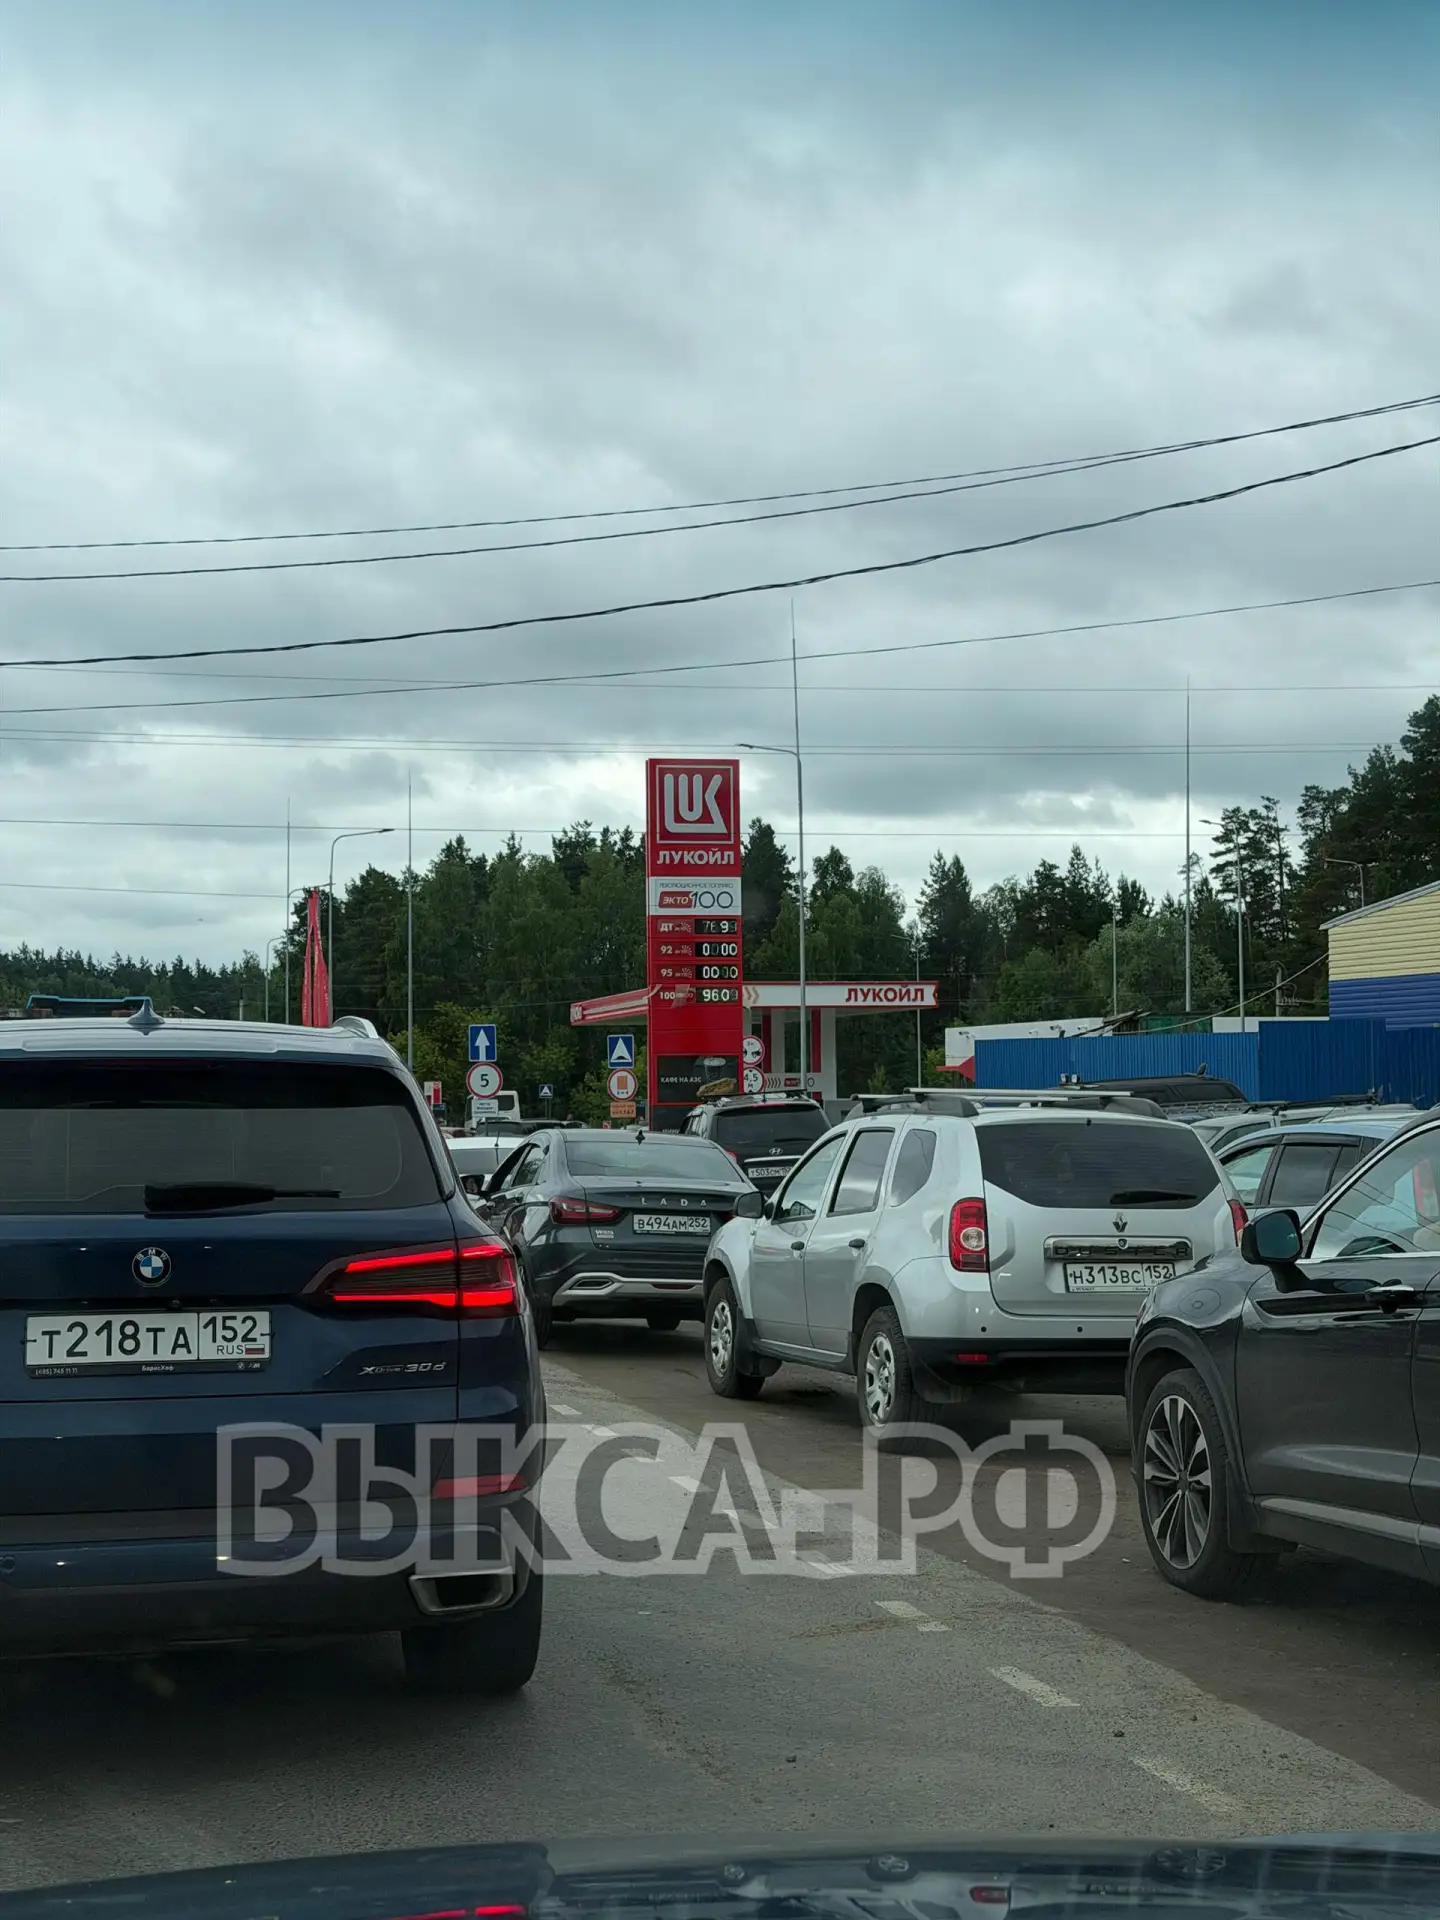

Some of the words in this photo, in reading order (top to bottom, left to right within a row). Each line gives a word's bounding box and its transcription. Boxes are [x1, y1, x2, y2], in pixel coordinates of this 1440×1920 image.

[656, 848, 734, 865] ЛУКОЙЛ
[662, 896, 689, 905] ЭКТО
[692, 891, 733, 909] 100
[660, 923, 674, 932] ДТ
[660, 946, 673, 954] 92
[660, 968, 673, 977] 95
[660, 991, 676, 999] 100
[845, 984, 924, 1002] ЛУКОЙЛ
[480, 1073, 489, 1087] 5
[660, 1076, 678, 1084] КАФЕ
[641, 1198, 707, 1206] LADA
[638, 1217, 687, 1231] В494АМ
[689, 1218, 708, 1228] 252
[1073, 1266, 1142, 1284] Н313ВС
[1145, 1265, 1172, 1279] 152
[41, 1320, 192, 1359] Т218ТА
[202, 1315, 258, 1343] 152
[216, 1345, 244, 1355] RUS
